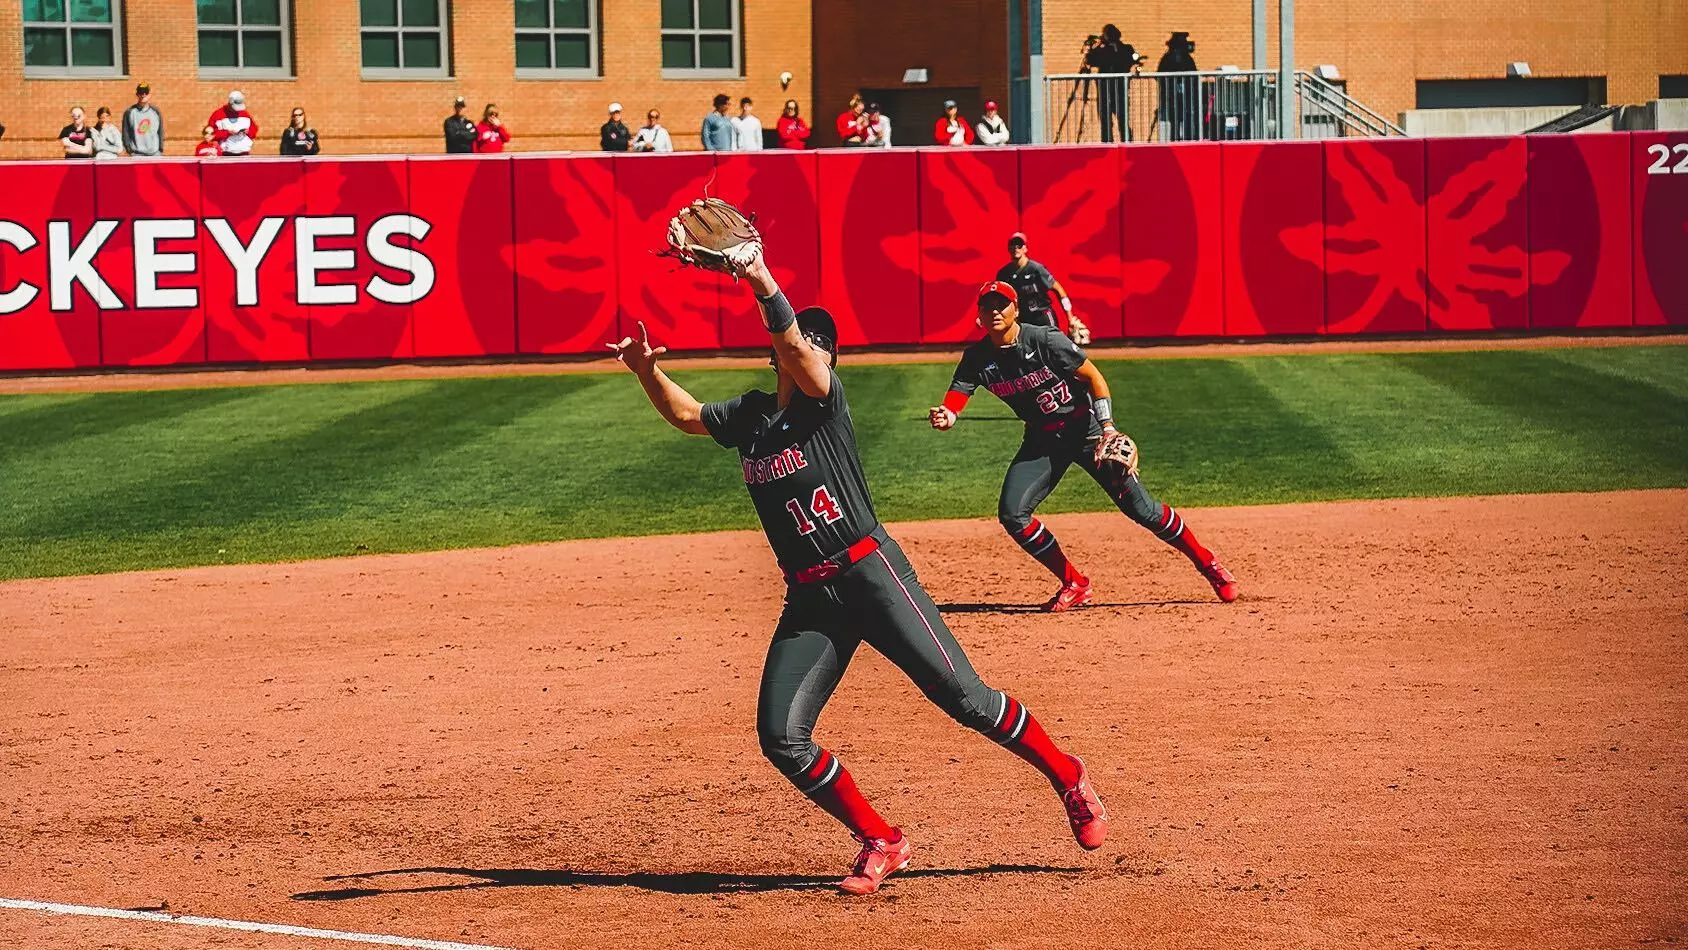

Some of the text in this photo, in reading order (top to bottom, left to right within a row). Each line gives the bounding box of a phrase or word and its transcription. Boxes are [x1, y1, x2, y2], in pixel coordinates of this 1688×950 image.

[1647, 143, 1688, 175] 22
[1036, 380, 1073, 414] 27
[755, 442, 809, 484] STATE
[785, 484, 844, 536] 14
